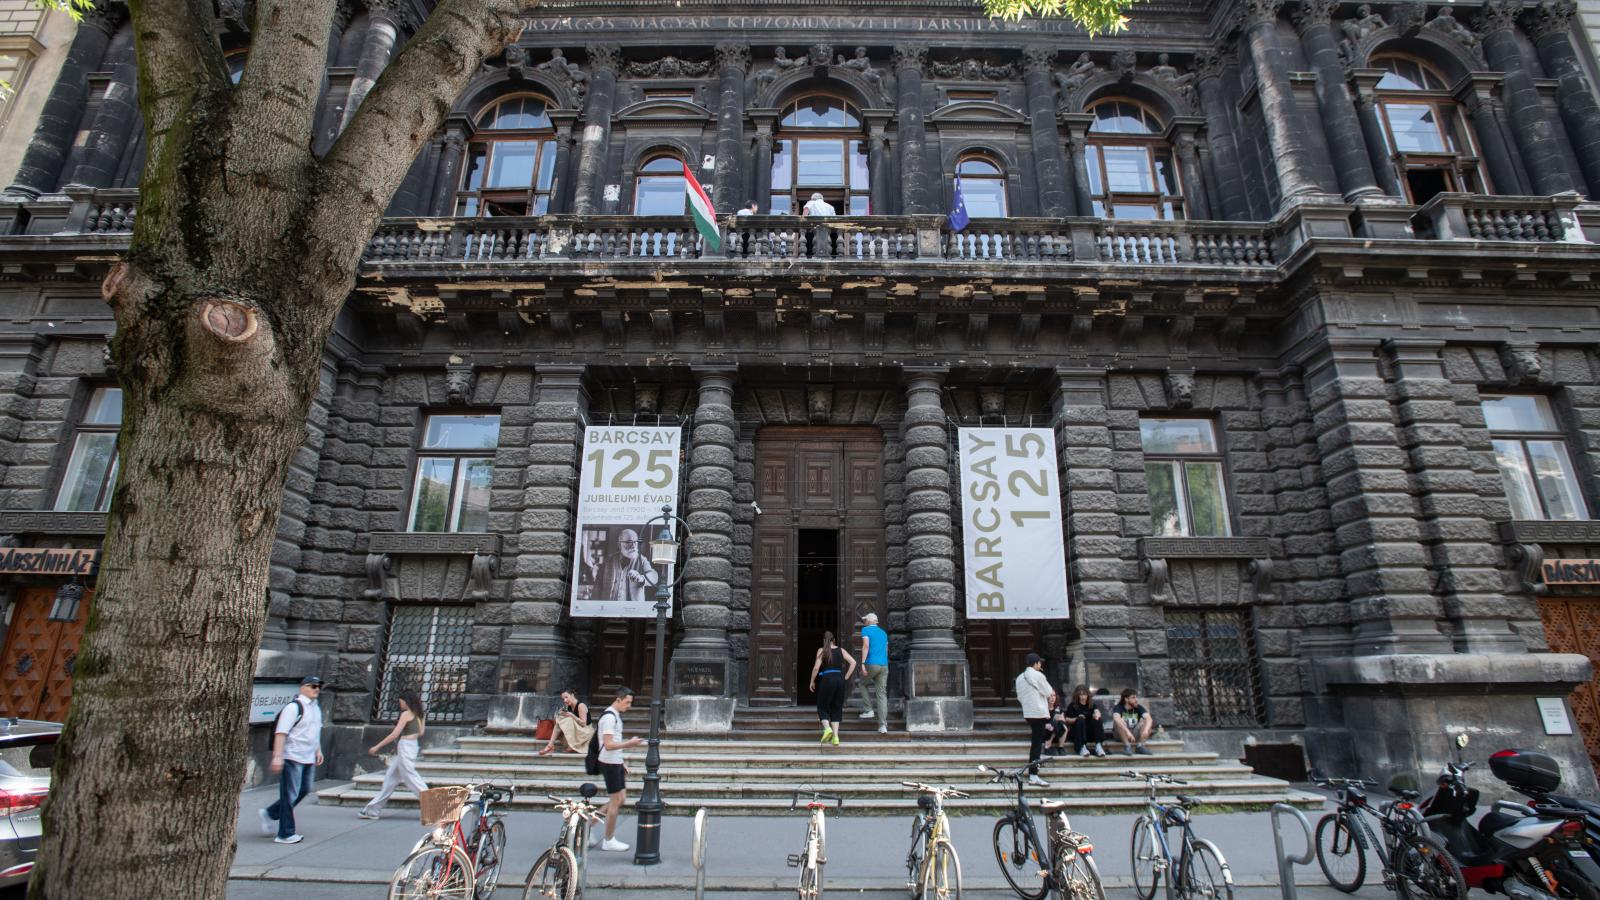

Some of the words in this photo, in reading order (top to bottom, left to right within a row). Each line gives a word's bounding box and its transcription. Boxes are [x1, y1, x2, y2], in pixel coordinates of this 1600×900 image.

[630, 17, 711, 29] MAGYAR
[590, 431, 675, 444] BARCSAY
[588, 449, 673, 488] 125
[1005, 433, 1050, 527] 125
[584, 494, 640, 503] JUBILEUMI
[643, 493, 672, 504] ÉVAD
[968, 433, 1005, 612] BARCSAY
